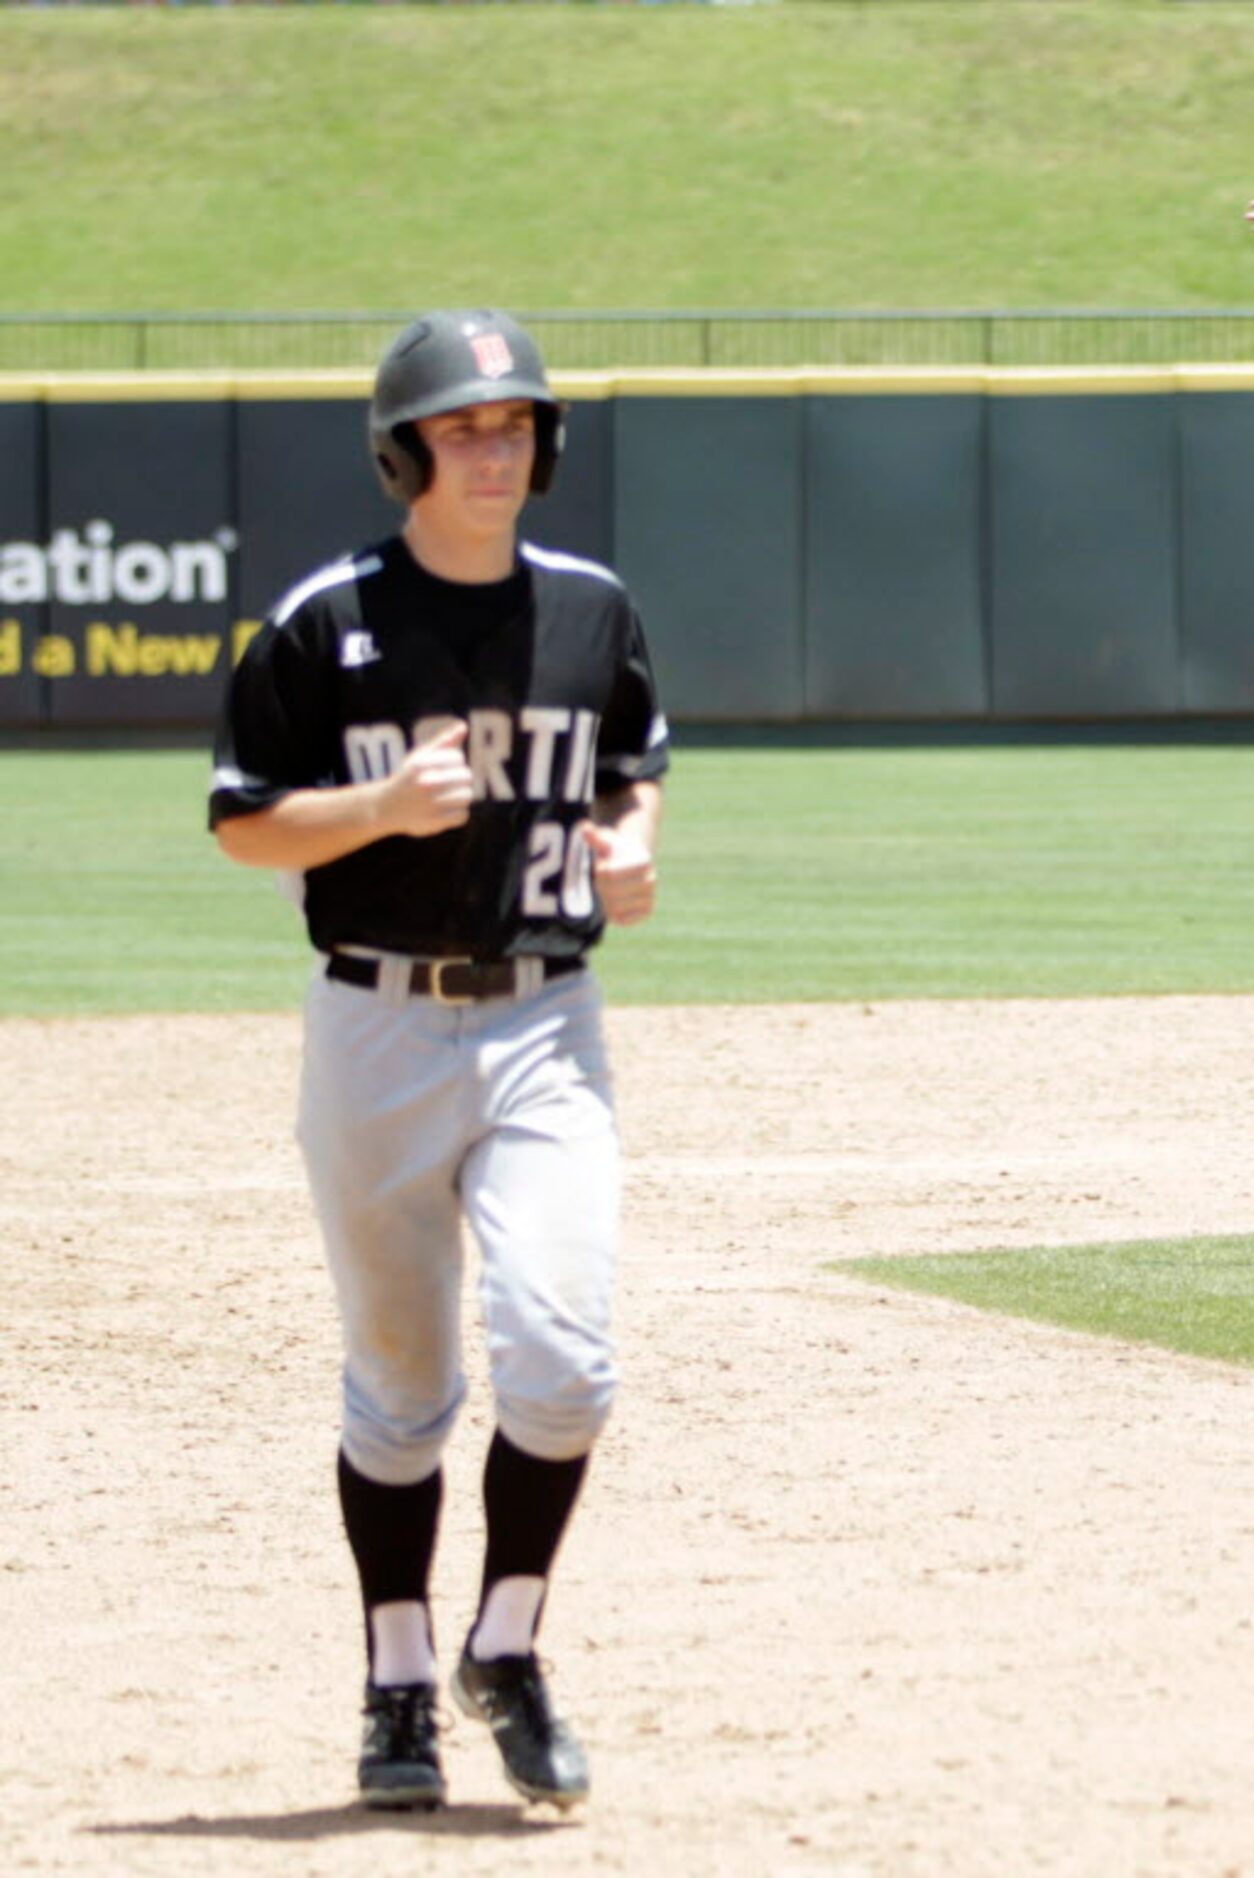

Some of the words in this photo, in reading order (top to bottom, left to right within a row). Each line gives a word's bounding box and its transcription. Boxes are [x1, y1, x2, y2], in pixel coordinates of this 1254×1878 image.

[0, 519, 227, 603] ation
[33, 634, 75, 676] a
[86, 620, 222, 676] New
[523, 821, 594, 917] 20
